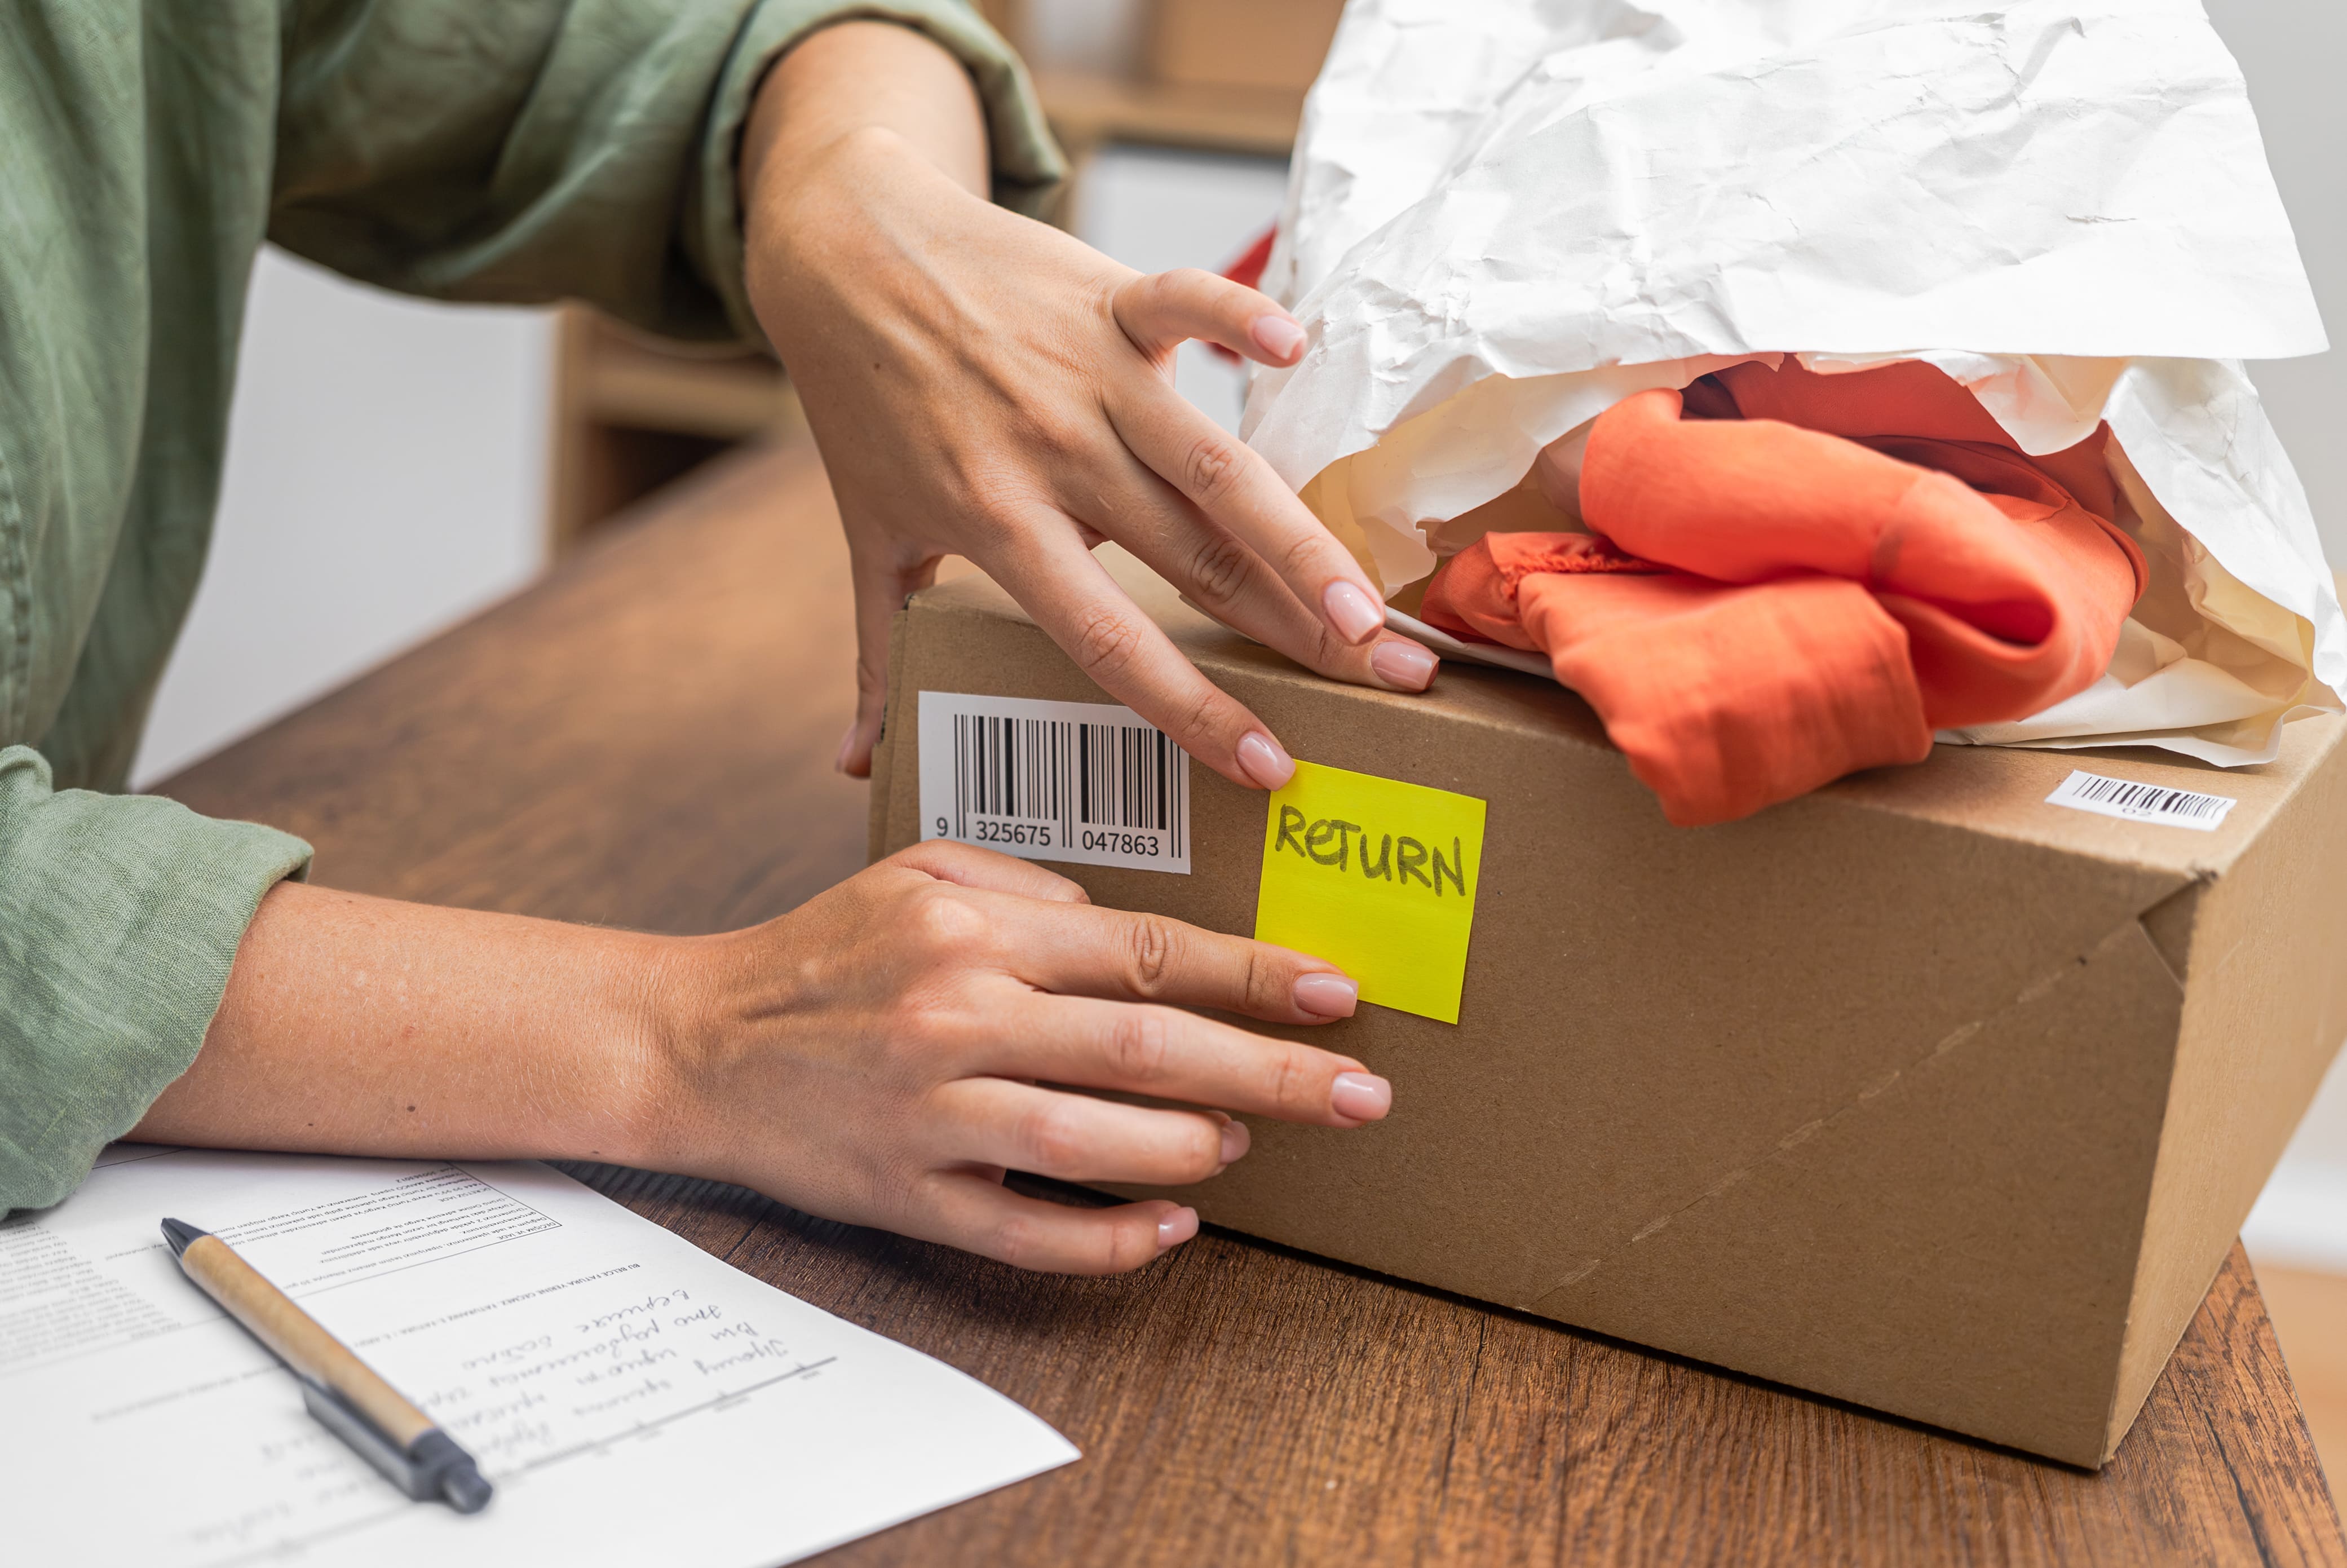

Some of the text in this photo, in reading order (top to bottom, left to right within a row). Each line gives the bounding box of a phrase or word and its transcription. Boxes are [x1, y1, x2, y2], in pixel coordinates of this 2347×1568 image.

[936, 817, 1159, 856] 9 325675 047863
[345, 1200, 377, 1209] şubesine
[426, 1211, 456, 1220] adresine
[437, 1215, 470, 1225] herhangi
[268, 1217, 305, 1229] paketinizi
[517, 1217, 547, 1226] Değişim
[601, 1266, 627, 1277] BELGE
[567, 1274, 602, 1285] FATURA
